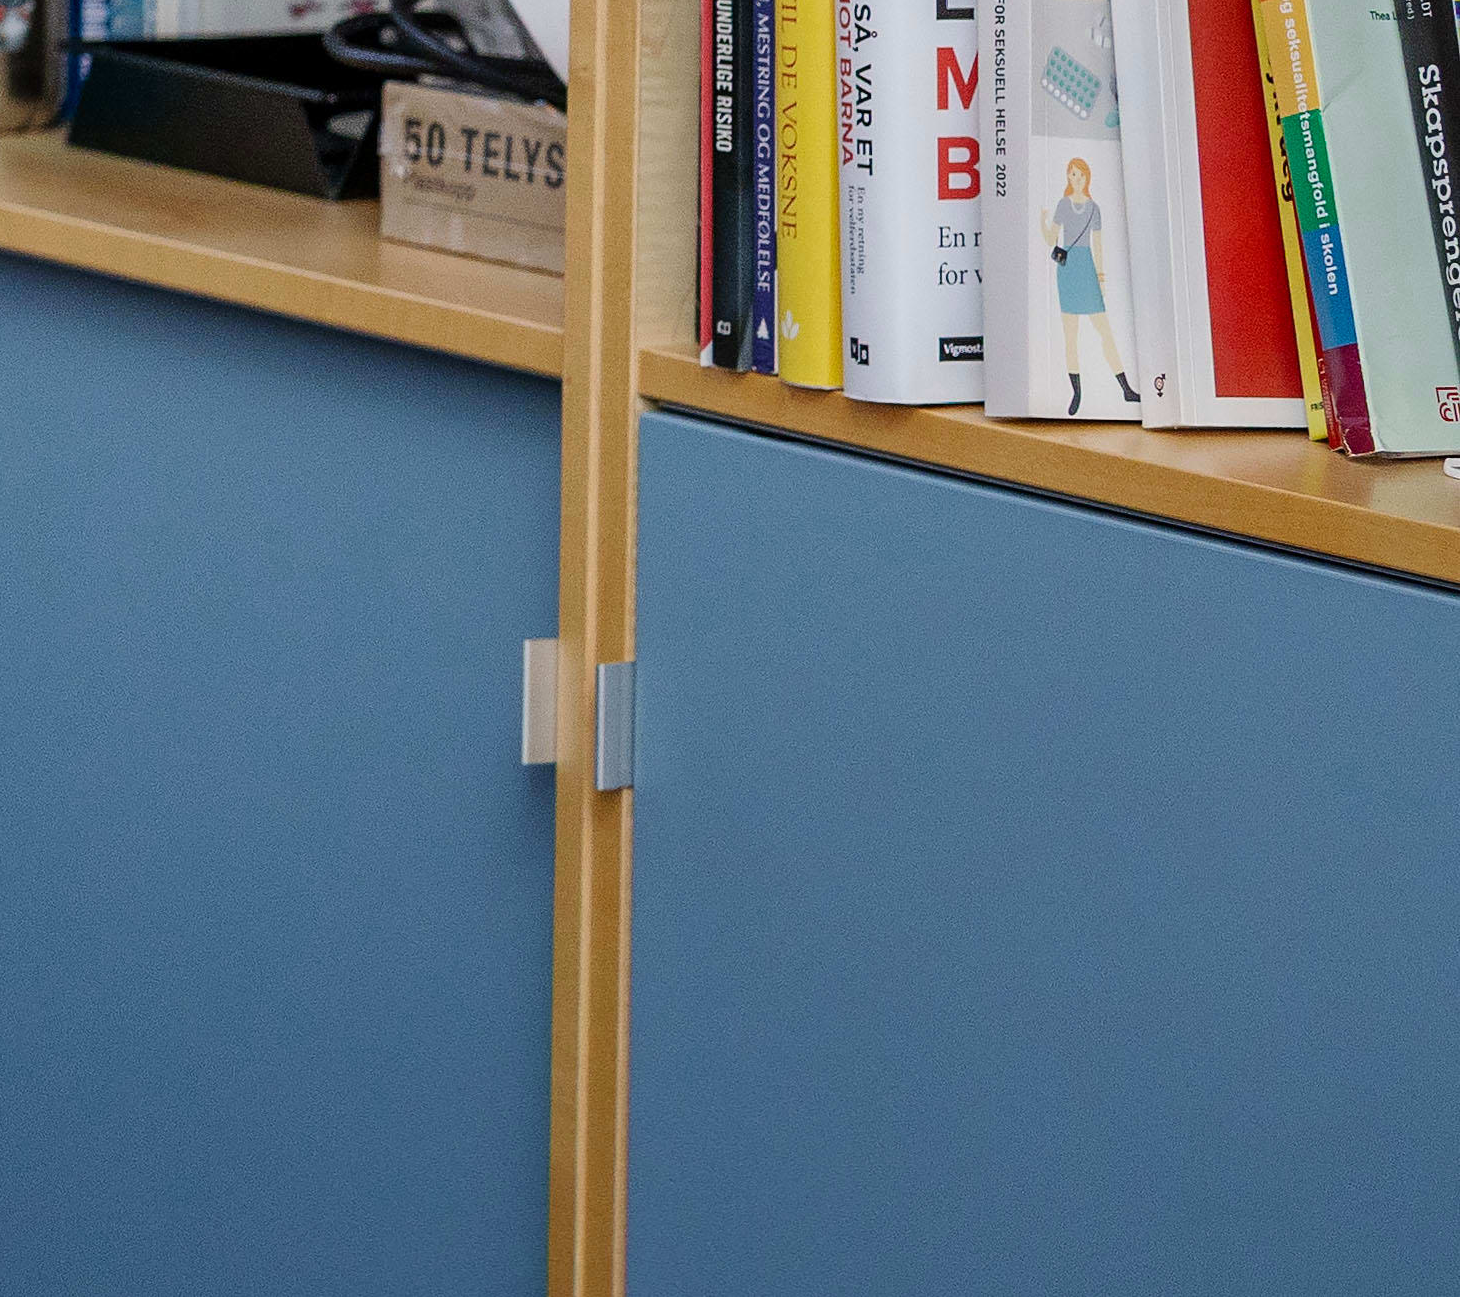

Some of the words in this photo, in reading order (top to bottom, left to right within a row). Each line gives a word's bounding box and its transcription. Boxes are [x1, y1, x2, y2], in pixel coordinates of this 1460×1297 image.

[853, 4, 878, 53] SÅ,
[1369, 10, 1391, 21] Thea
[756, 12, 771, 119] MESTRING
[781, 45, 798, 90] DE
[994, 28, 1006, 105] SEKSUELL
[840, 58, 854, 167] BARNA
[855, 64, 872, 128] VAR
[716, 96, 734, 153] RISIKO
[756, 123, 771, 159] OG
[995, 108, 1007, 157] HELSE
[405, 116, 446, 167] 50
[460, 126, 565, 189] TELYS
[781, 101, 798, 240] VOKSNE
[856, 138, 873, 176] ET
[1284, 18, 1330, 219] seksualitetsmangfold
[1320, 233, 1339, 296] skolen
[996, 163, 1007, 198] 2022
[756, 163, 772, 293] MEDFØLELSE
[938, 225, 966, 248] En
[938, 261, 968, 286] for
